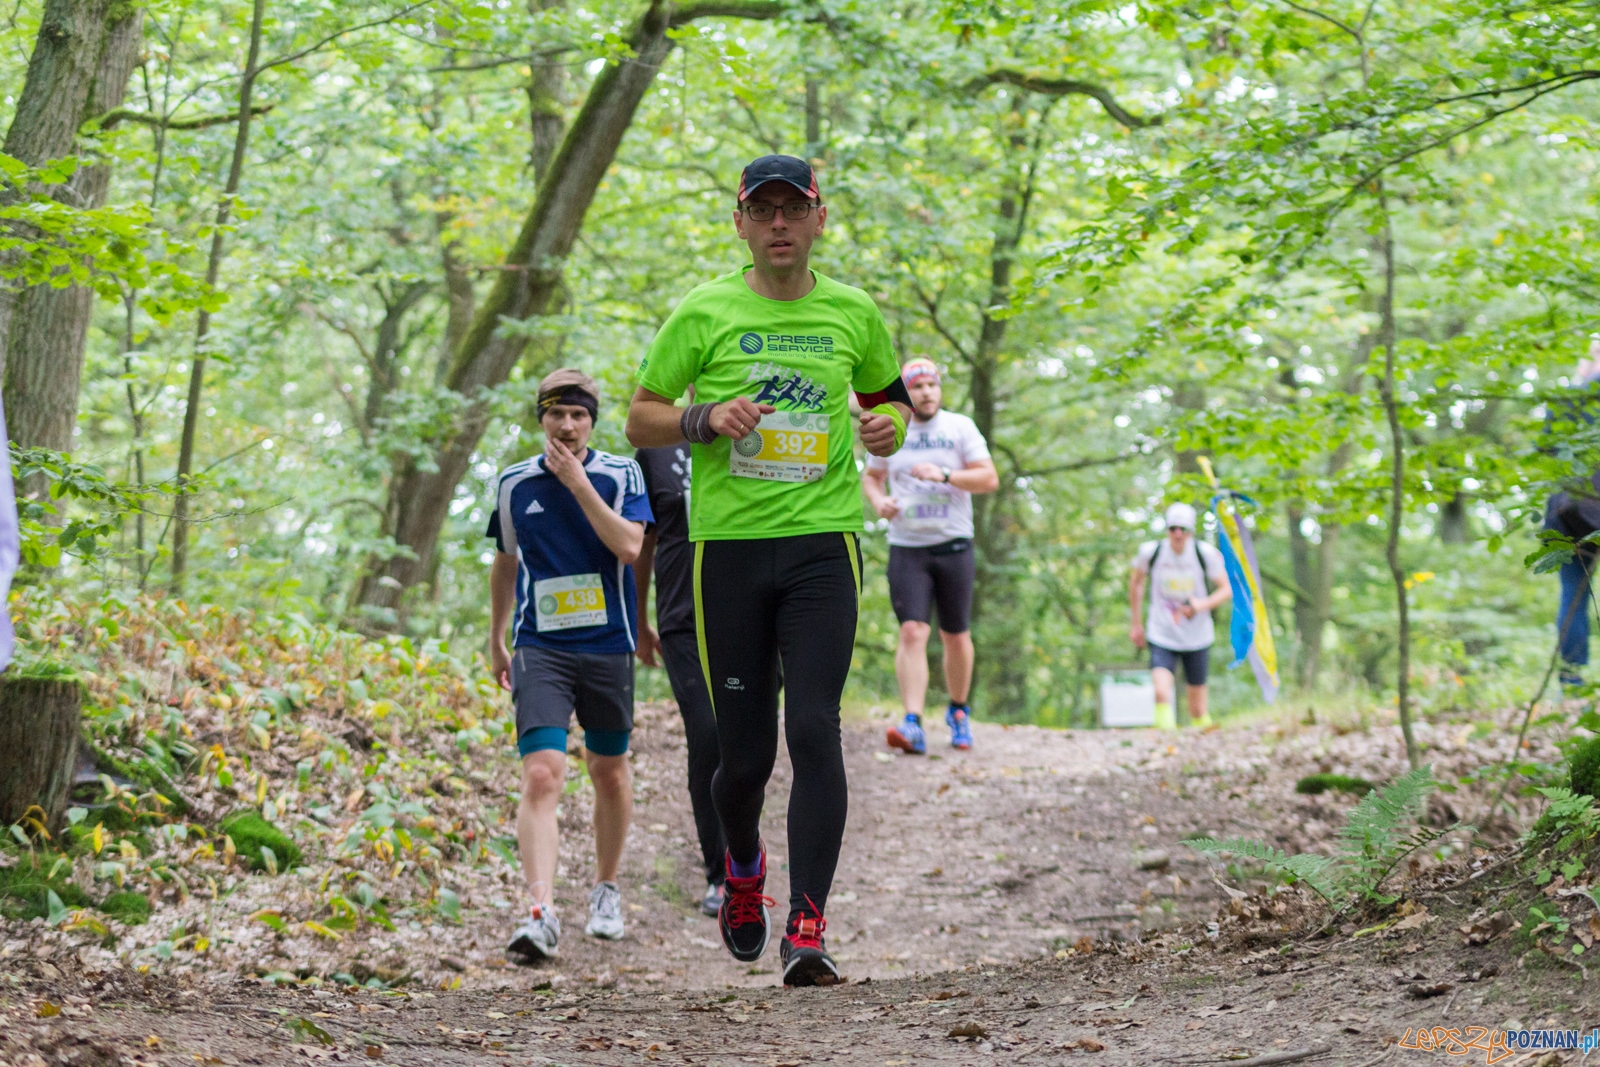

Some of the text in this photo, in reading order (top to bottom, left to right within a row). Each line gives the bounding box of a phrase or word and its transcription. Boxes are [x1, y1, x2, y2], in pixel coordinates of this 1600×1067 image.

[767, 334, 834, 345] PRESS
[767, 344, 834, 353] SERVICE
[774, 432, 817, 456] 392
[565, 589, 598, 608] 438
